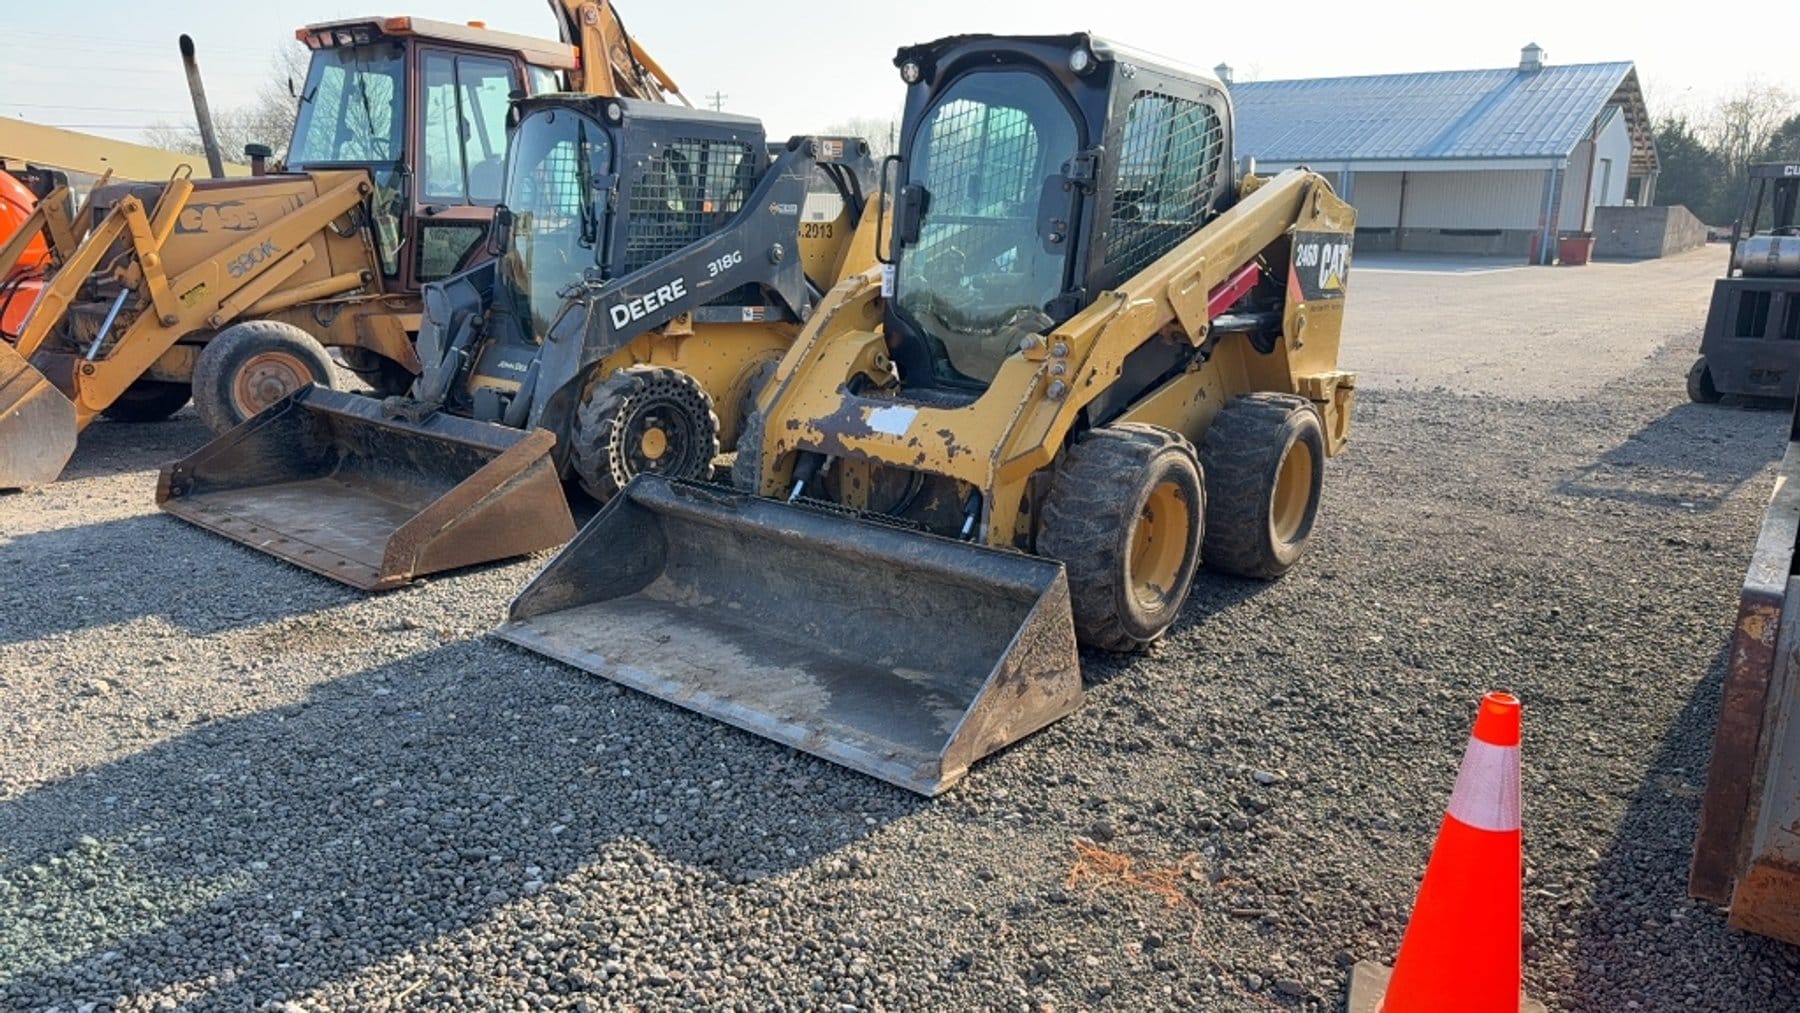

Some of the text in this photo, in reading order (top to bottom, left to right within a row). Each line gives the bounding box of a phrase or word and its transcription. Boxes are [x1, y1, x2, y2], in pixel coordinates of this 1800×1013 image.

[798, 223, 833, 239] .2013
[707, 249, 742, 278] 318G
[1296, 243, 1319, 267] 246D
[1318, 243, 1348, 289] CAT
[609, 277, 687, 330] DEERE
